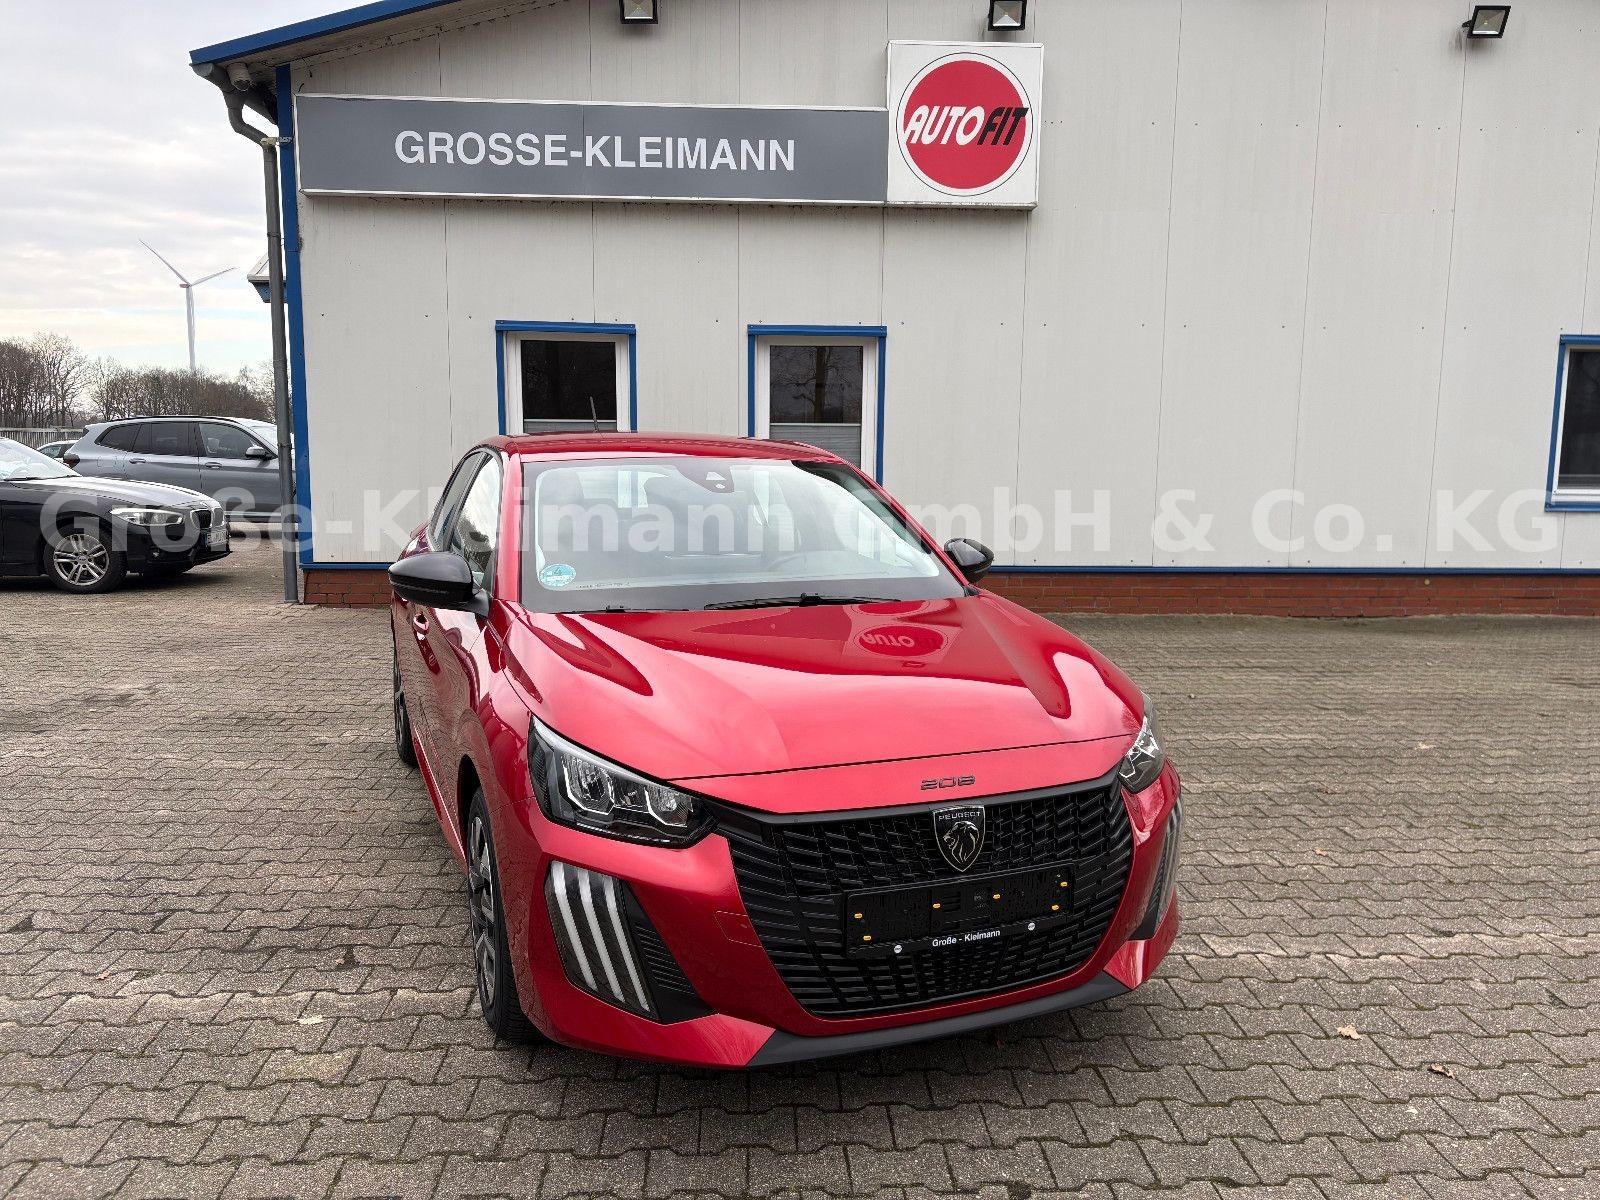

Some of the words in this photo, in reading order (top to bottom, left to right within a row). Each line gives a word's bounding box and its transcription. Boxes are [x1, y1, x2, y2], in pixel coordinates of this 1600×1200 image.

[394, 130, 795, 171] GROSSE-KLEIMANN
[920, 775, 976, 791] 208
[938, 811, 982, 822] PEUGEOT
[932, 936, 957, 947] Große
[964, 929, 1001, 942] Kleimann
